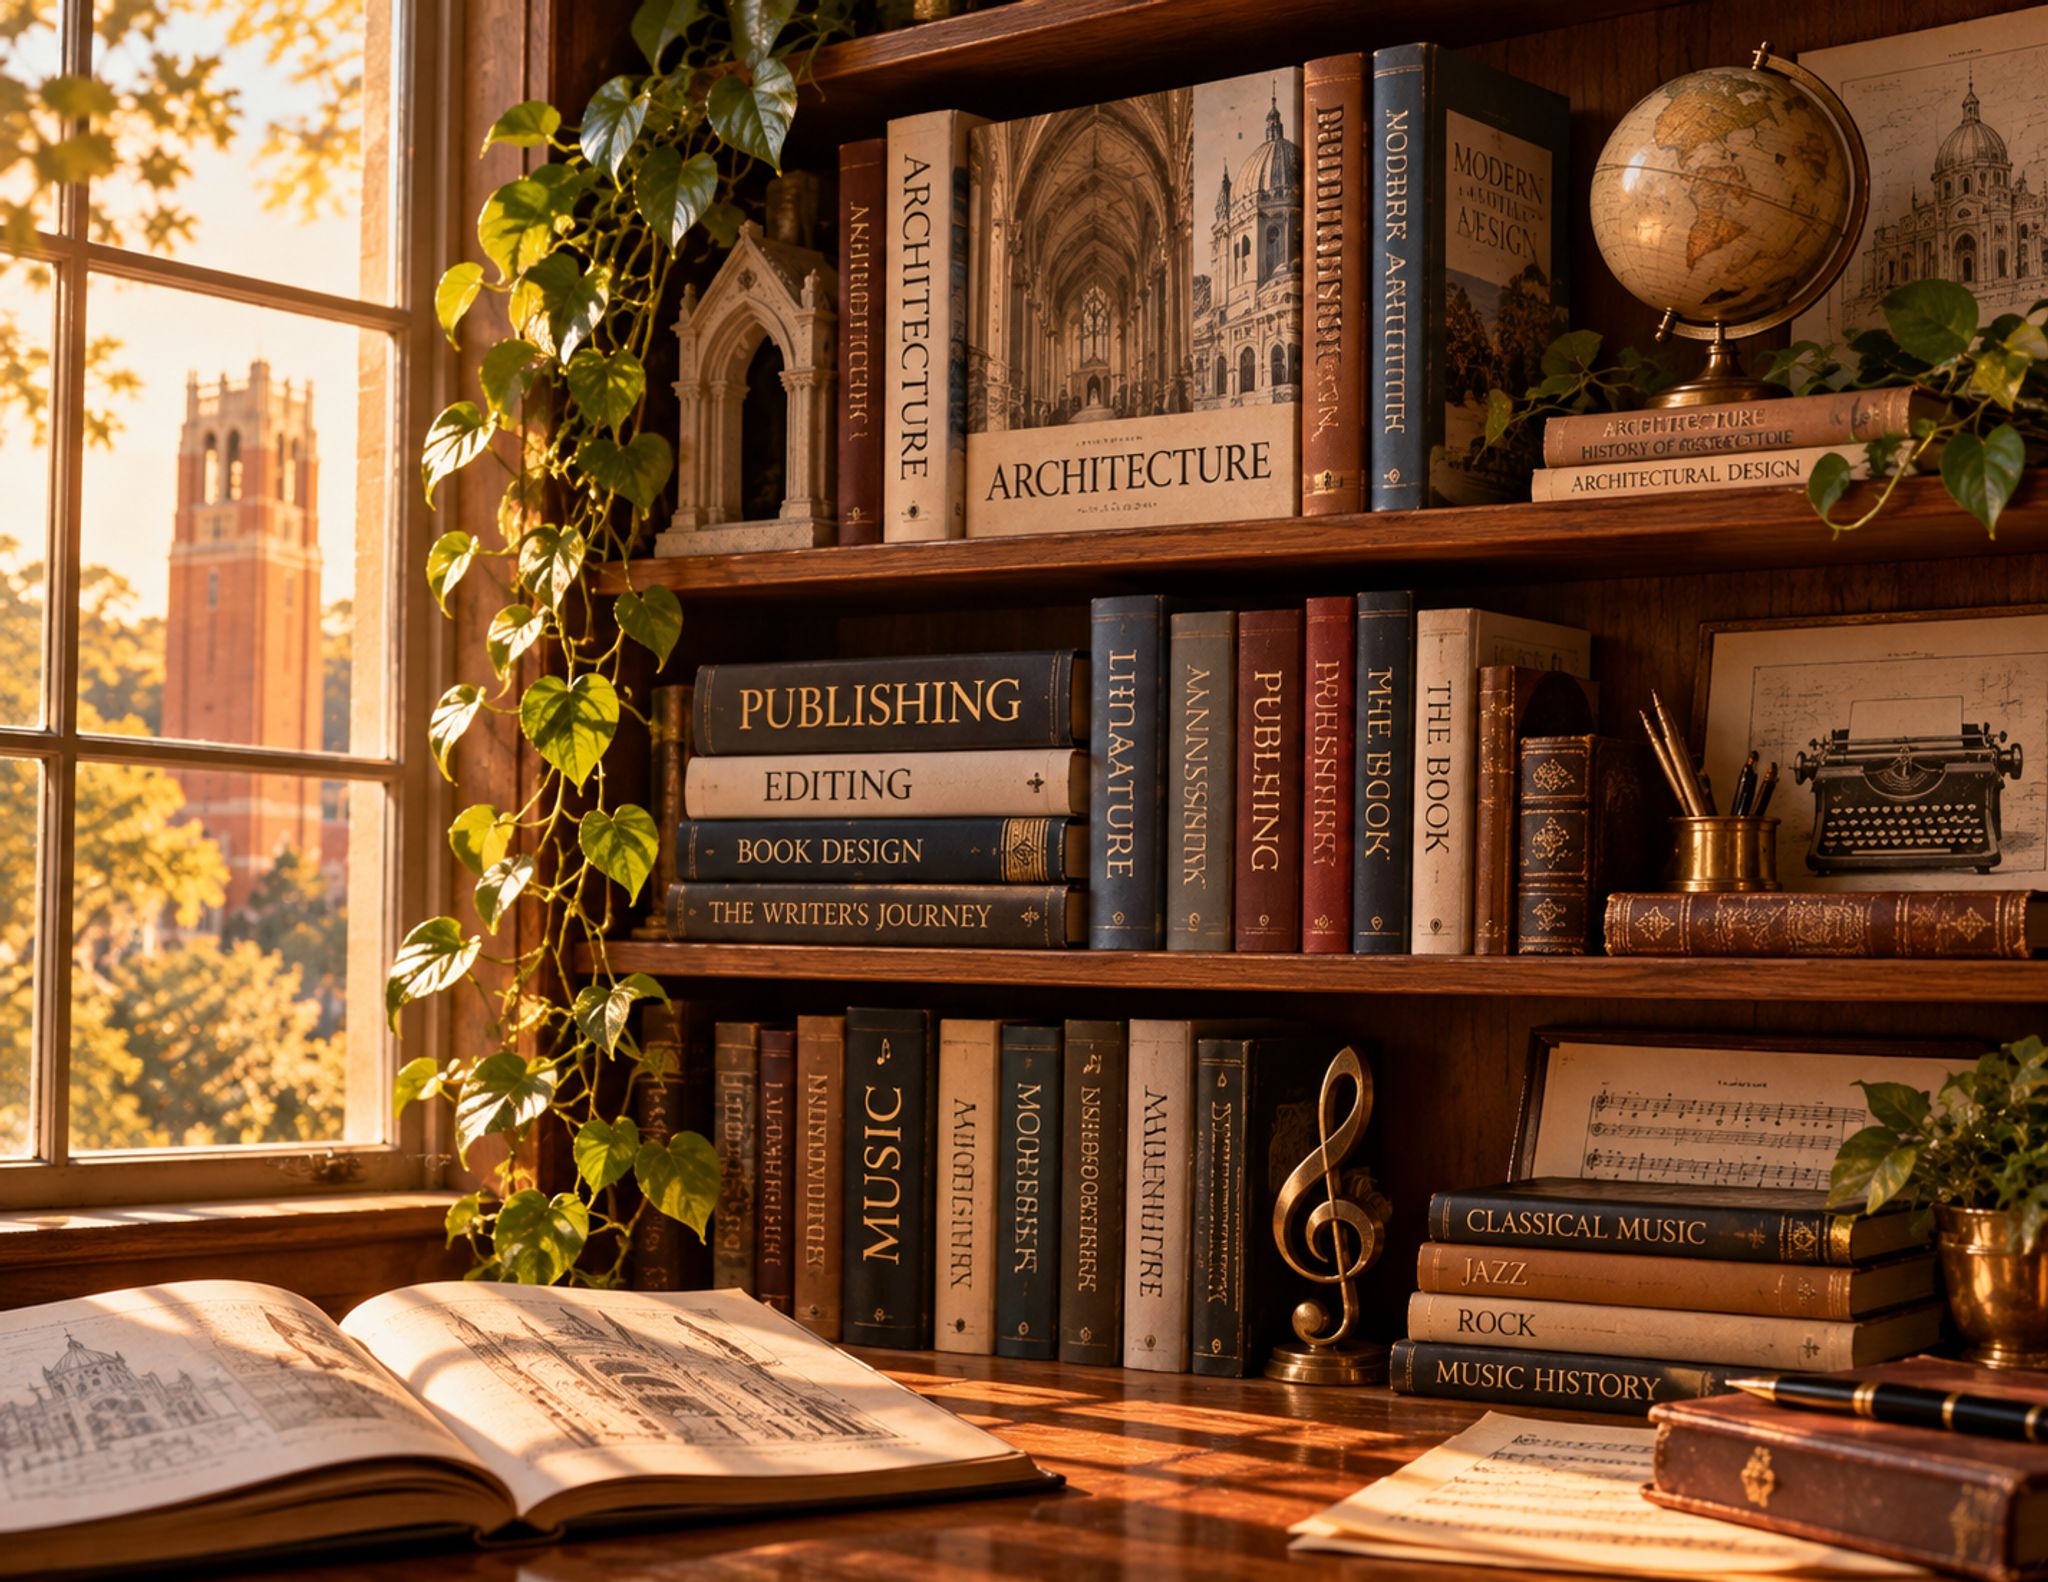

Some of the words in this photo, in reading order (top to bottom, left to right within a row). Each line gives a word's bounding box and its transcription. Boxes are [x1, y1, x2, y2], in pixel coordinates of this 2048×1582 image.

[1454, 141, 1544, 205] MODERN
[899, 153, 932, 481] ARCHITECTURE
[1581, 440, 1649, 461] HISTORY
[1653, 438, 1675, 456] OF
[985, 441, 1272, 502] ARCHITECTURE
[1571, 465, 1721, 494] ARCHITECTURAL
[1728, 459, 1801, 482] DESIGN
[738, 678, 1022, 730] PUBLISHING
[1426, 680, 1452, 747] THE
[764, 768, 912, 802] EDITING
[1424, 755, 1452, 856] BOOK
[737, 839, 813, 864] BOOK
[821, 838, 924, 864] DESIGN
[709, 901, 754, 924] THE
[763, 902, 869, 926] WRITER'S
[876, 902, 992, 932] JOURNEY
[863, 1085, 902, 1265] MUSIC
[1466, 1208, 1608, 1240] CLASSICAL
[1616, 1216, 1707, 1245] MUSIC
[1461, 1257, 1528, 1287] JAZZ
[1457, 1308, 1537, 1337] ROCK
[1436, 1360, 1525, 1389] MUSIC
[1534, 1367, 1662, 1400] HISTORY
